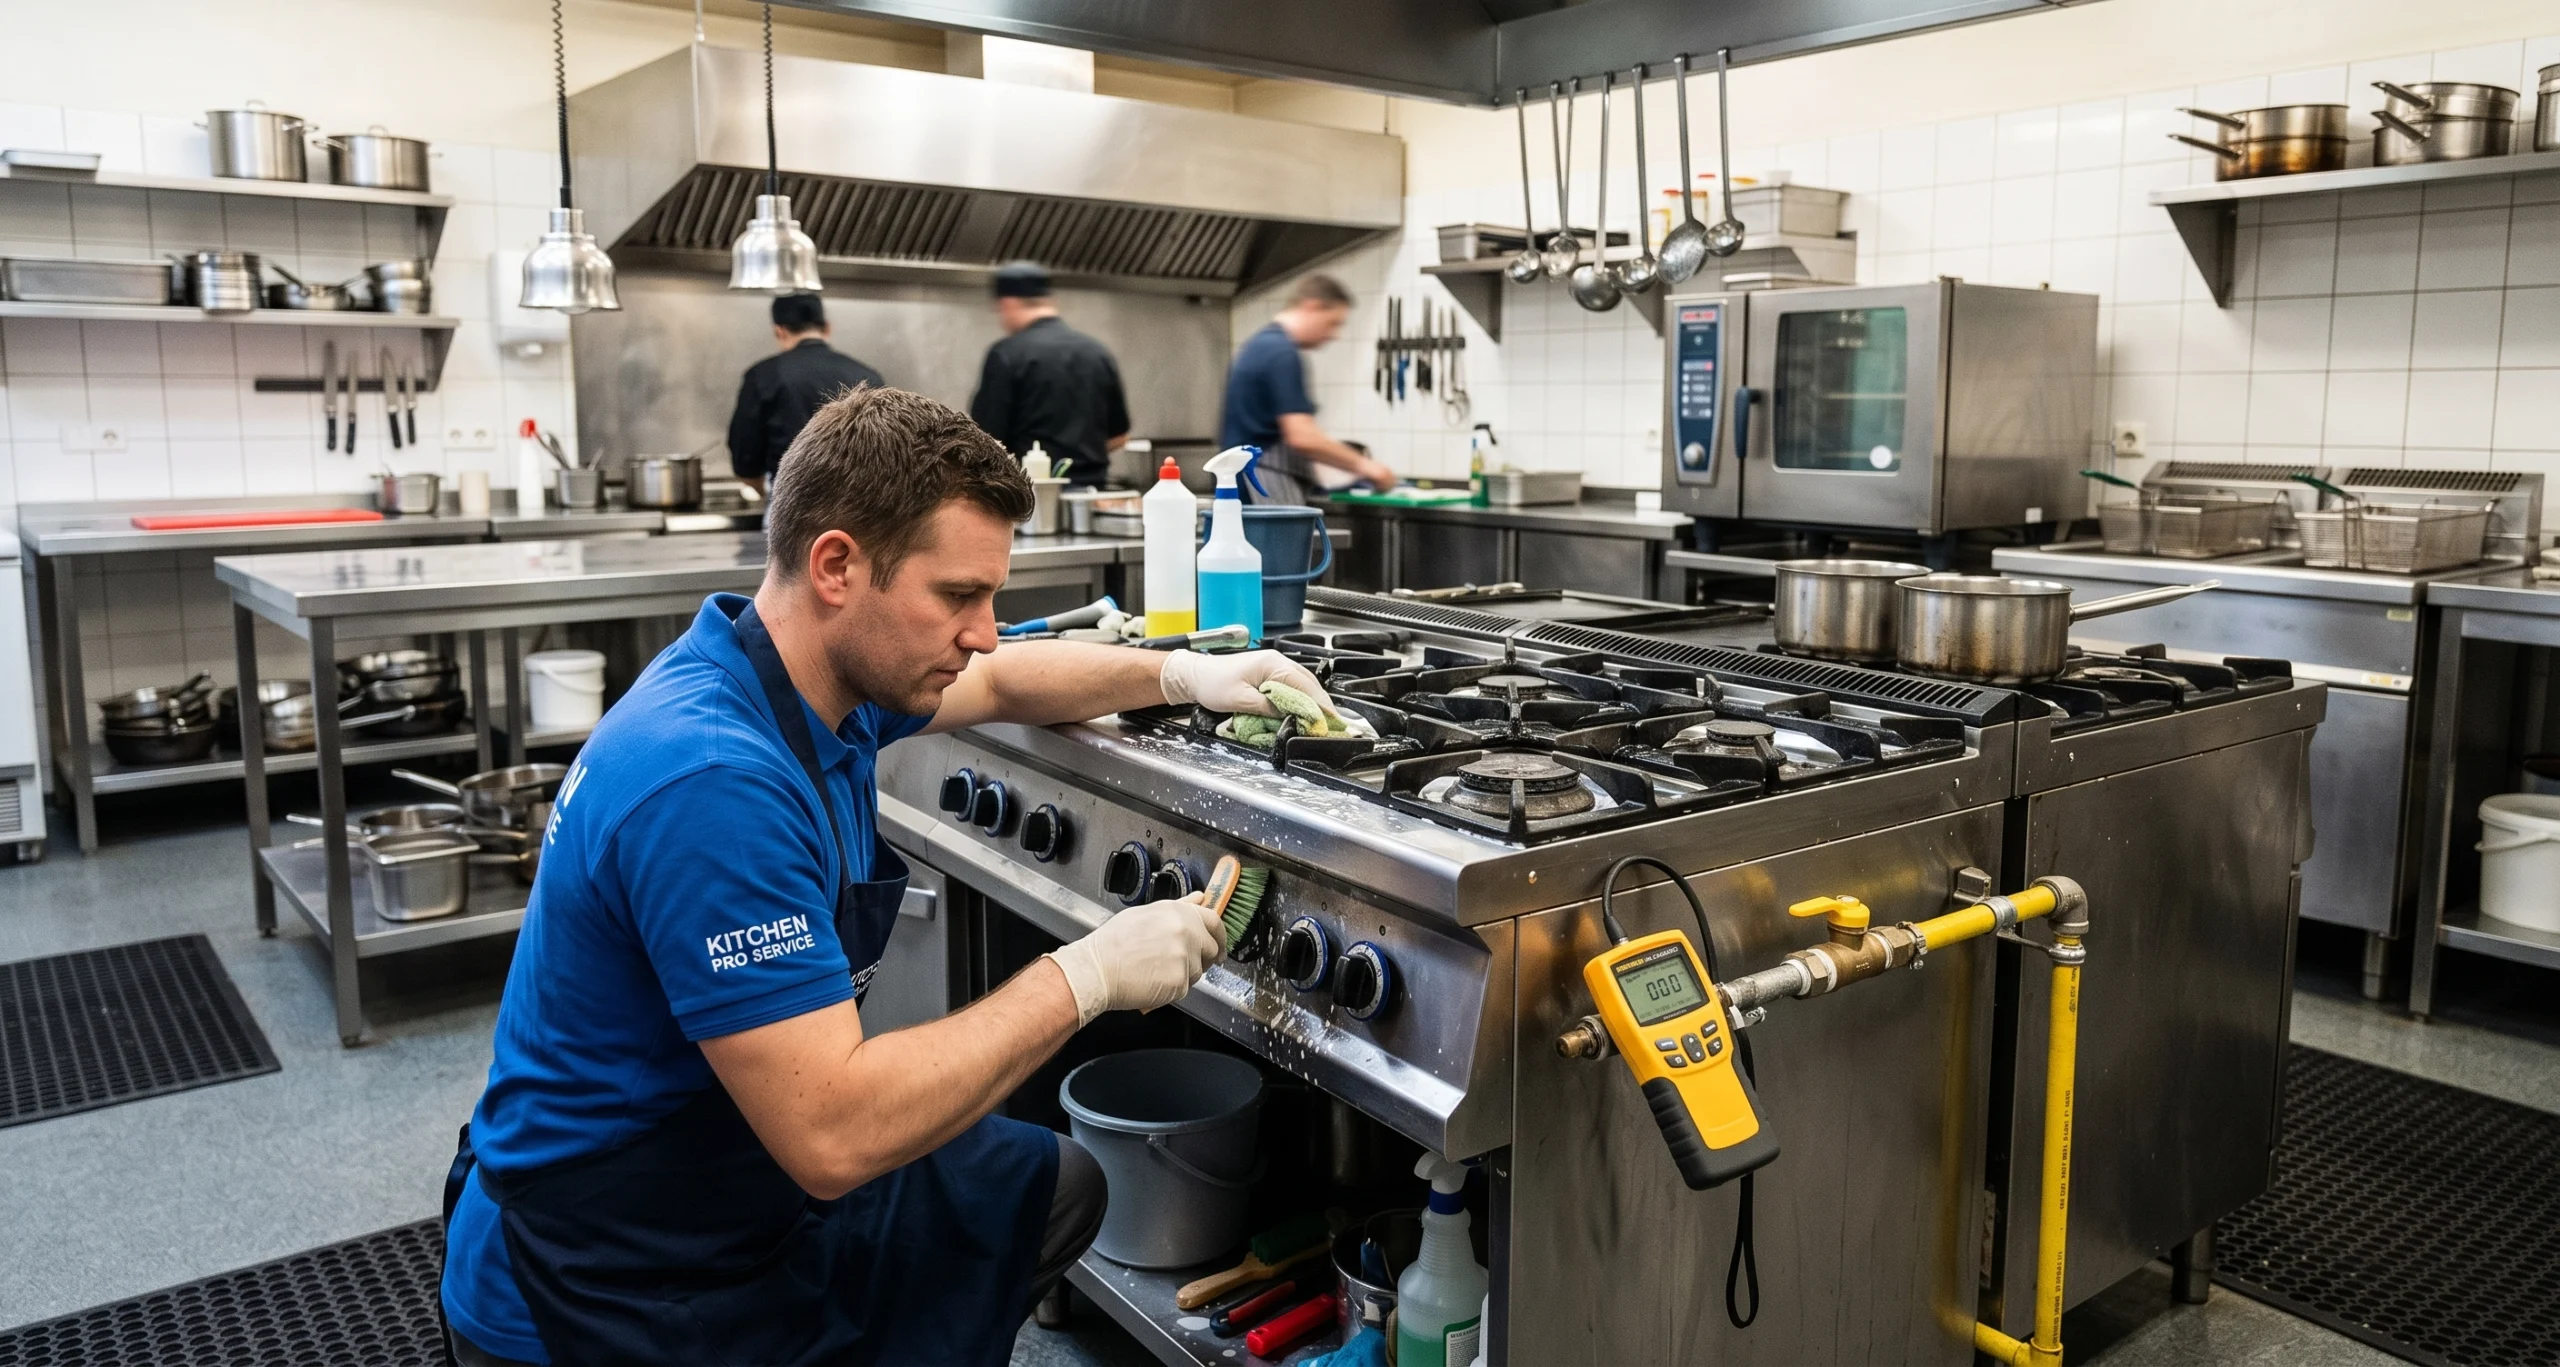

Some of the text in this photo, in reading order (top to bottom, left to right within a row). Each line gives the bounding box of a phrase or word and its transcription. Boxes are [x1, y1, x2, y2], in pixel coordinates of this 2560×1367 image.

[706, 914, 809, 957] KITCHEN
[711, 934, 816, 973] PRO SERVICE
[1646, 973, 1682, 1001] 000
